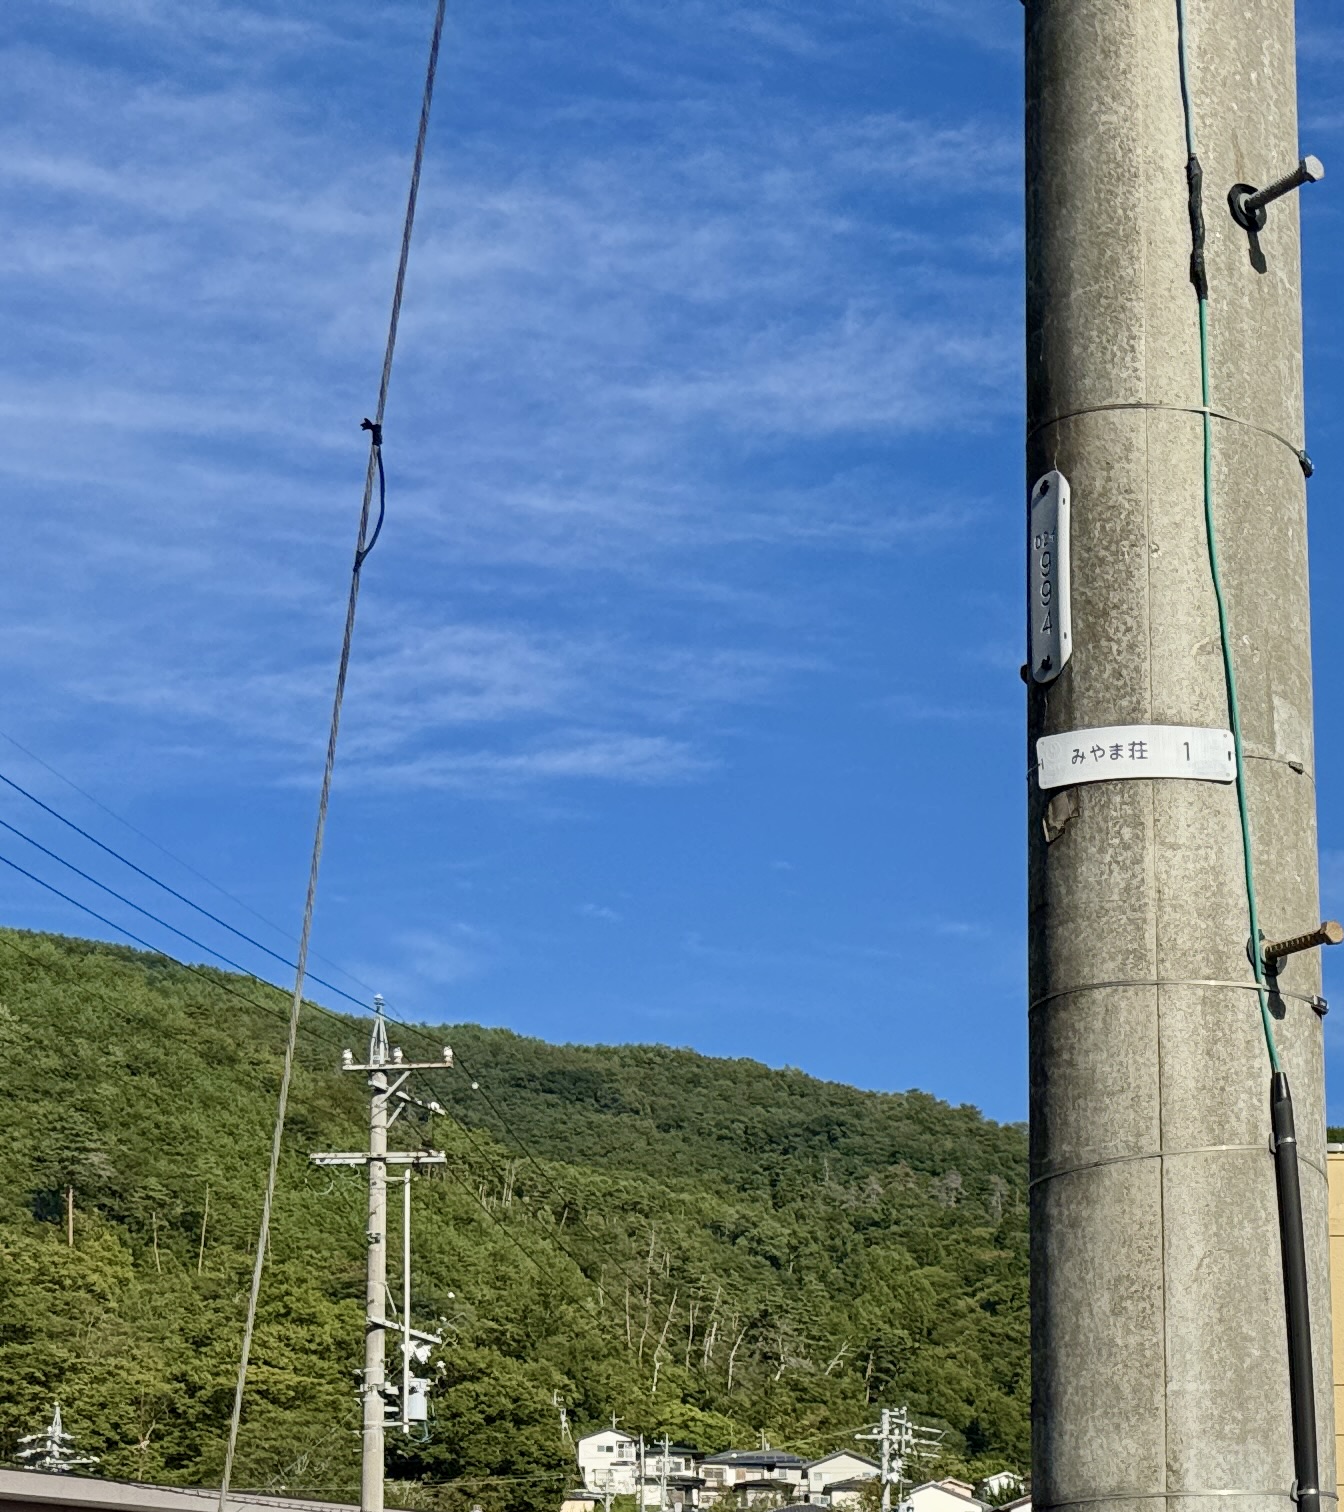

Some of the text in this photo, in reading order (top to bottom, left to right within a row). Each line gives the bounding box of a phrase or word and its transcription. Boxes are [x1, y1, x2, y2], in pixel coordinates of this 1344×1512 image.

[1040, 551, 1053, 634] 994
[1071, 740, 1191, 765] みやま荘 1
